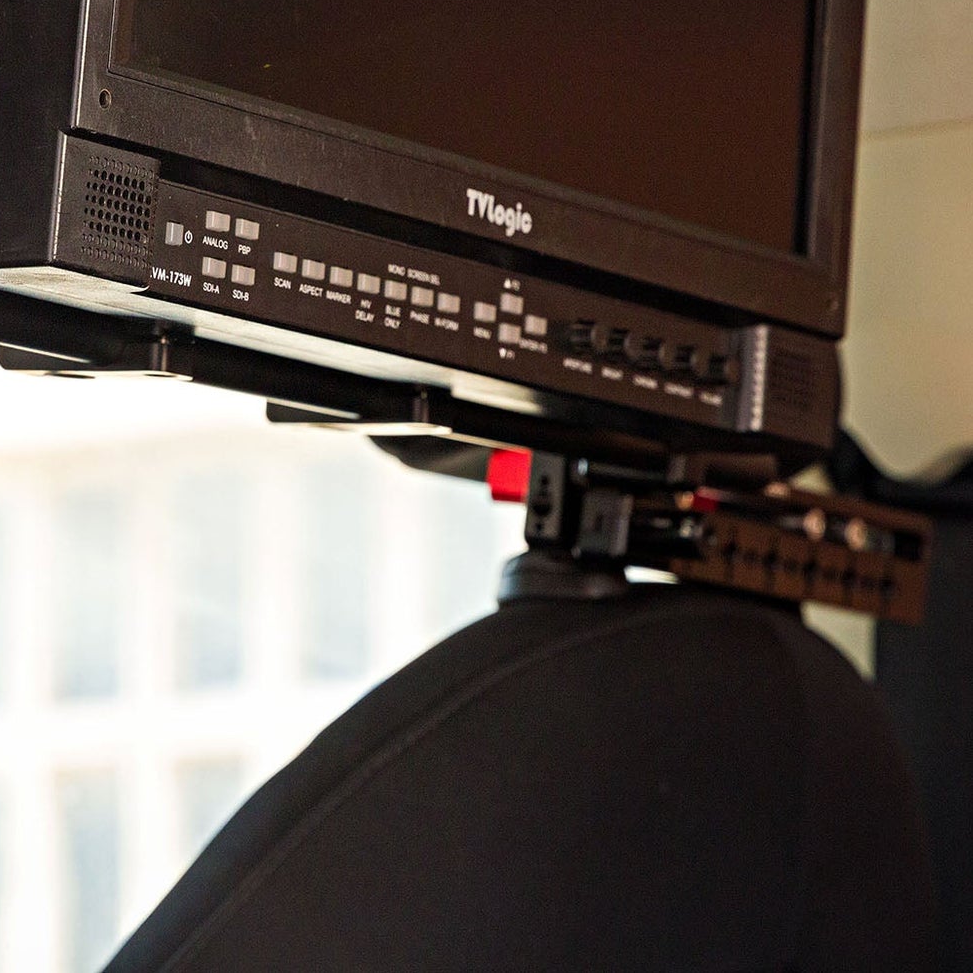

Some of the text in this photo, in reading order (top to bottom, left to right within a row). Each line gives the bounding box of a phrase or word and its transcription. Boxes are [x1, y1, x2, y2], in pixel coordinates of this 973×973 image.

[466, 188, 533, 237] TVlogic
[202, 235, 229, 250] ANALOG
[238, 244, 252, 256] PBP
[151, 266, 193, 287] VM-173W
[273, 276, 292, 290] SCAN
[202, 281, 220, 294] SDI-A
[232, 289, 250, 301] SDI-B
[298, 283, 324, 298] ASPECT
[325, 290, 352, 305] MARKER
